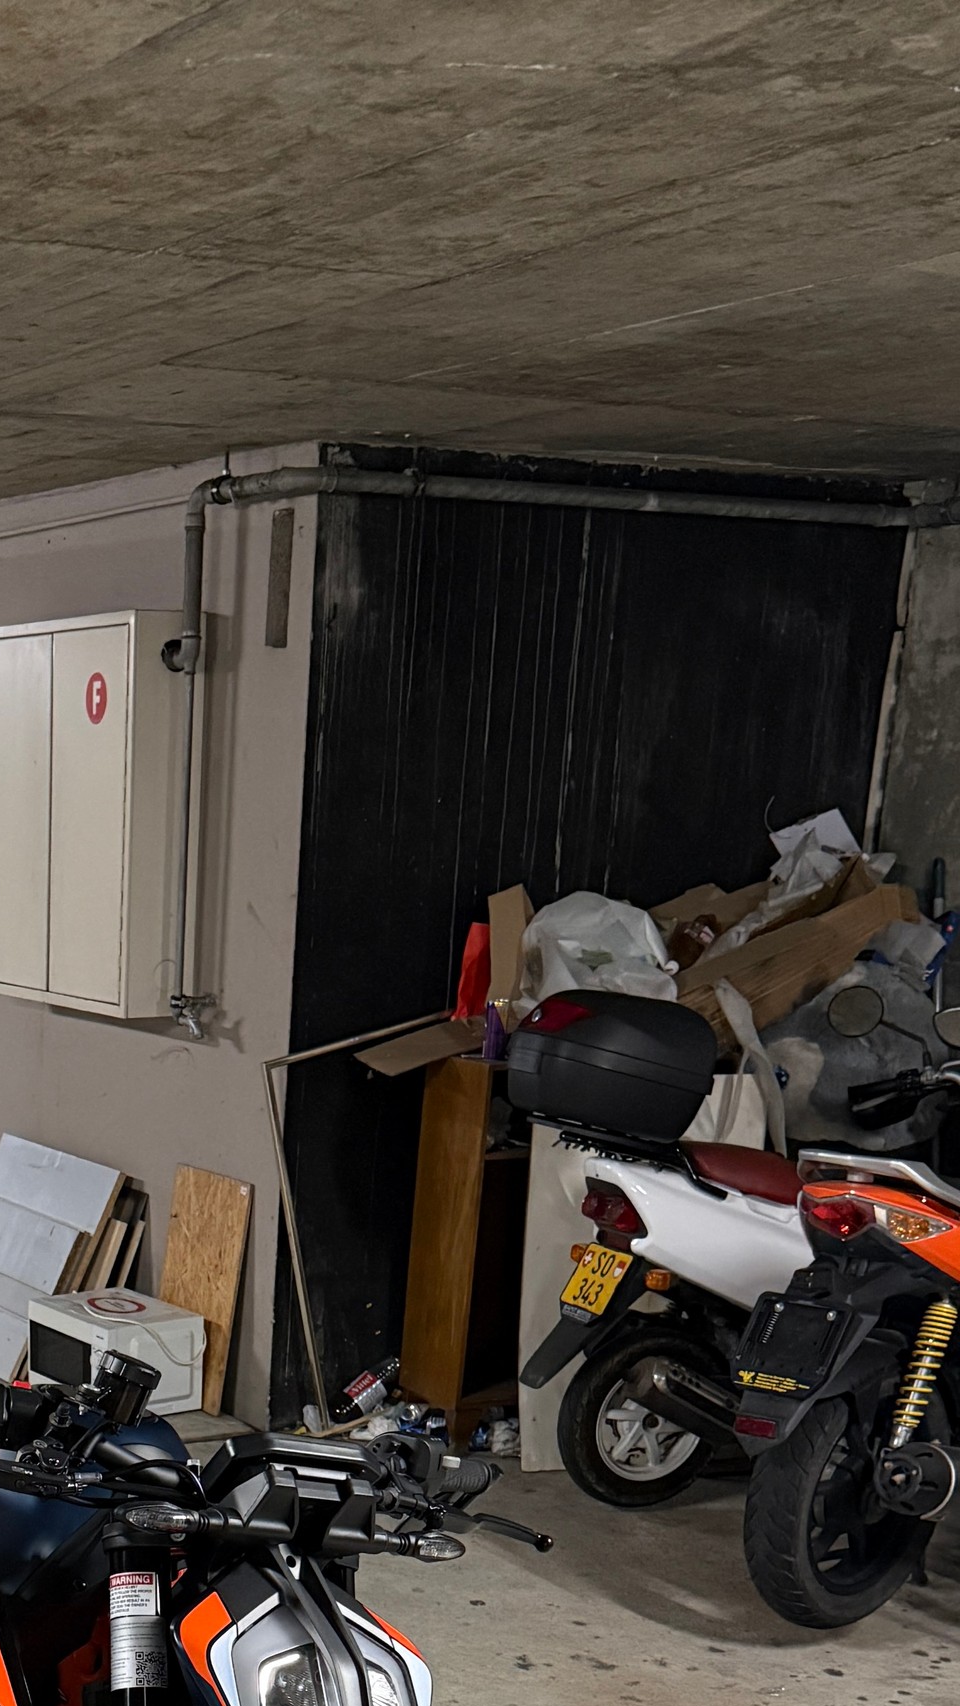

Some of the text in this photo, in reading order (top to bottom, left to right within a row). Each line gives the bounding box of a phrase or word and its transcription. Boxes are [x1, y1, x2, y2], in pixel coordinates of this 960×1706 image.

[92, 680, 102, 715] F
[591, 1252, 616, 1278] SO
[572, 1277, 604, 1306] 343
[111, 1574, 151, 1586] WARNING
